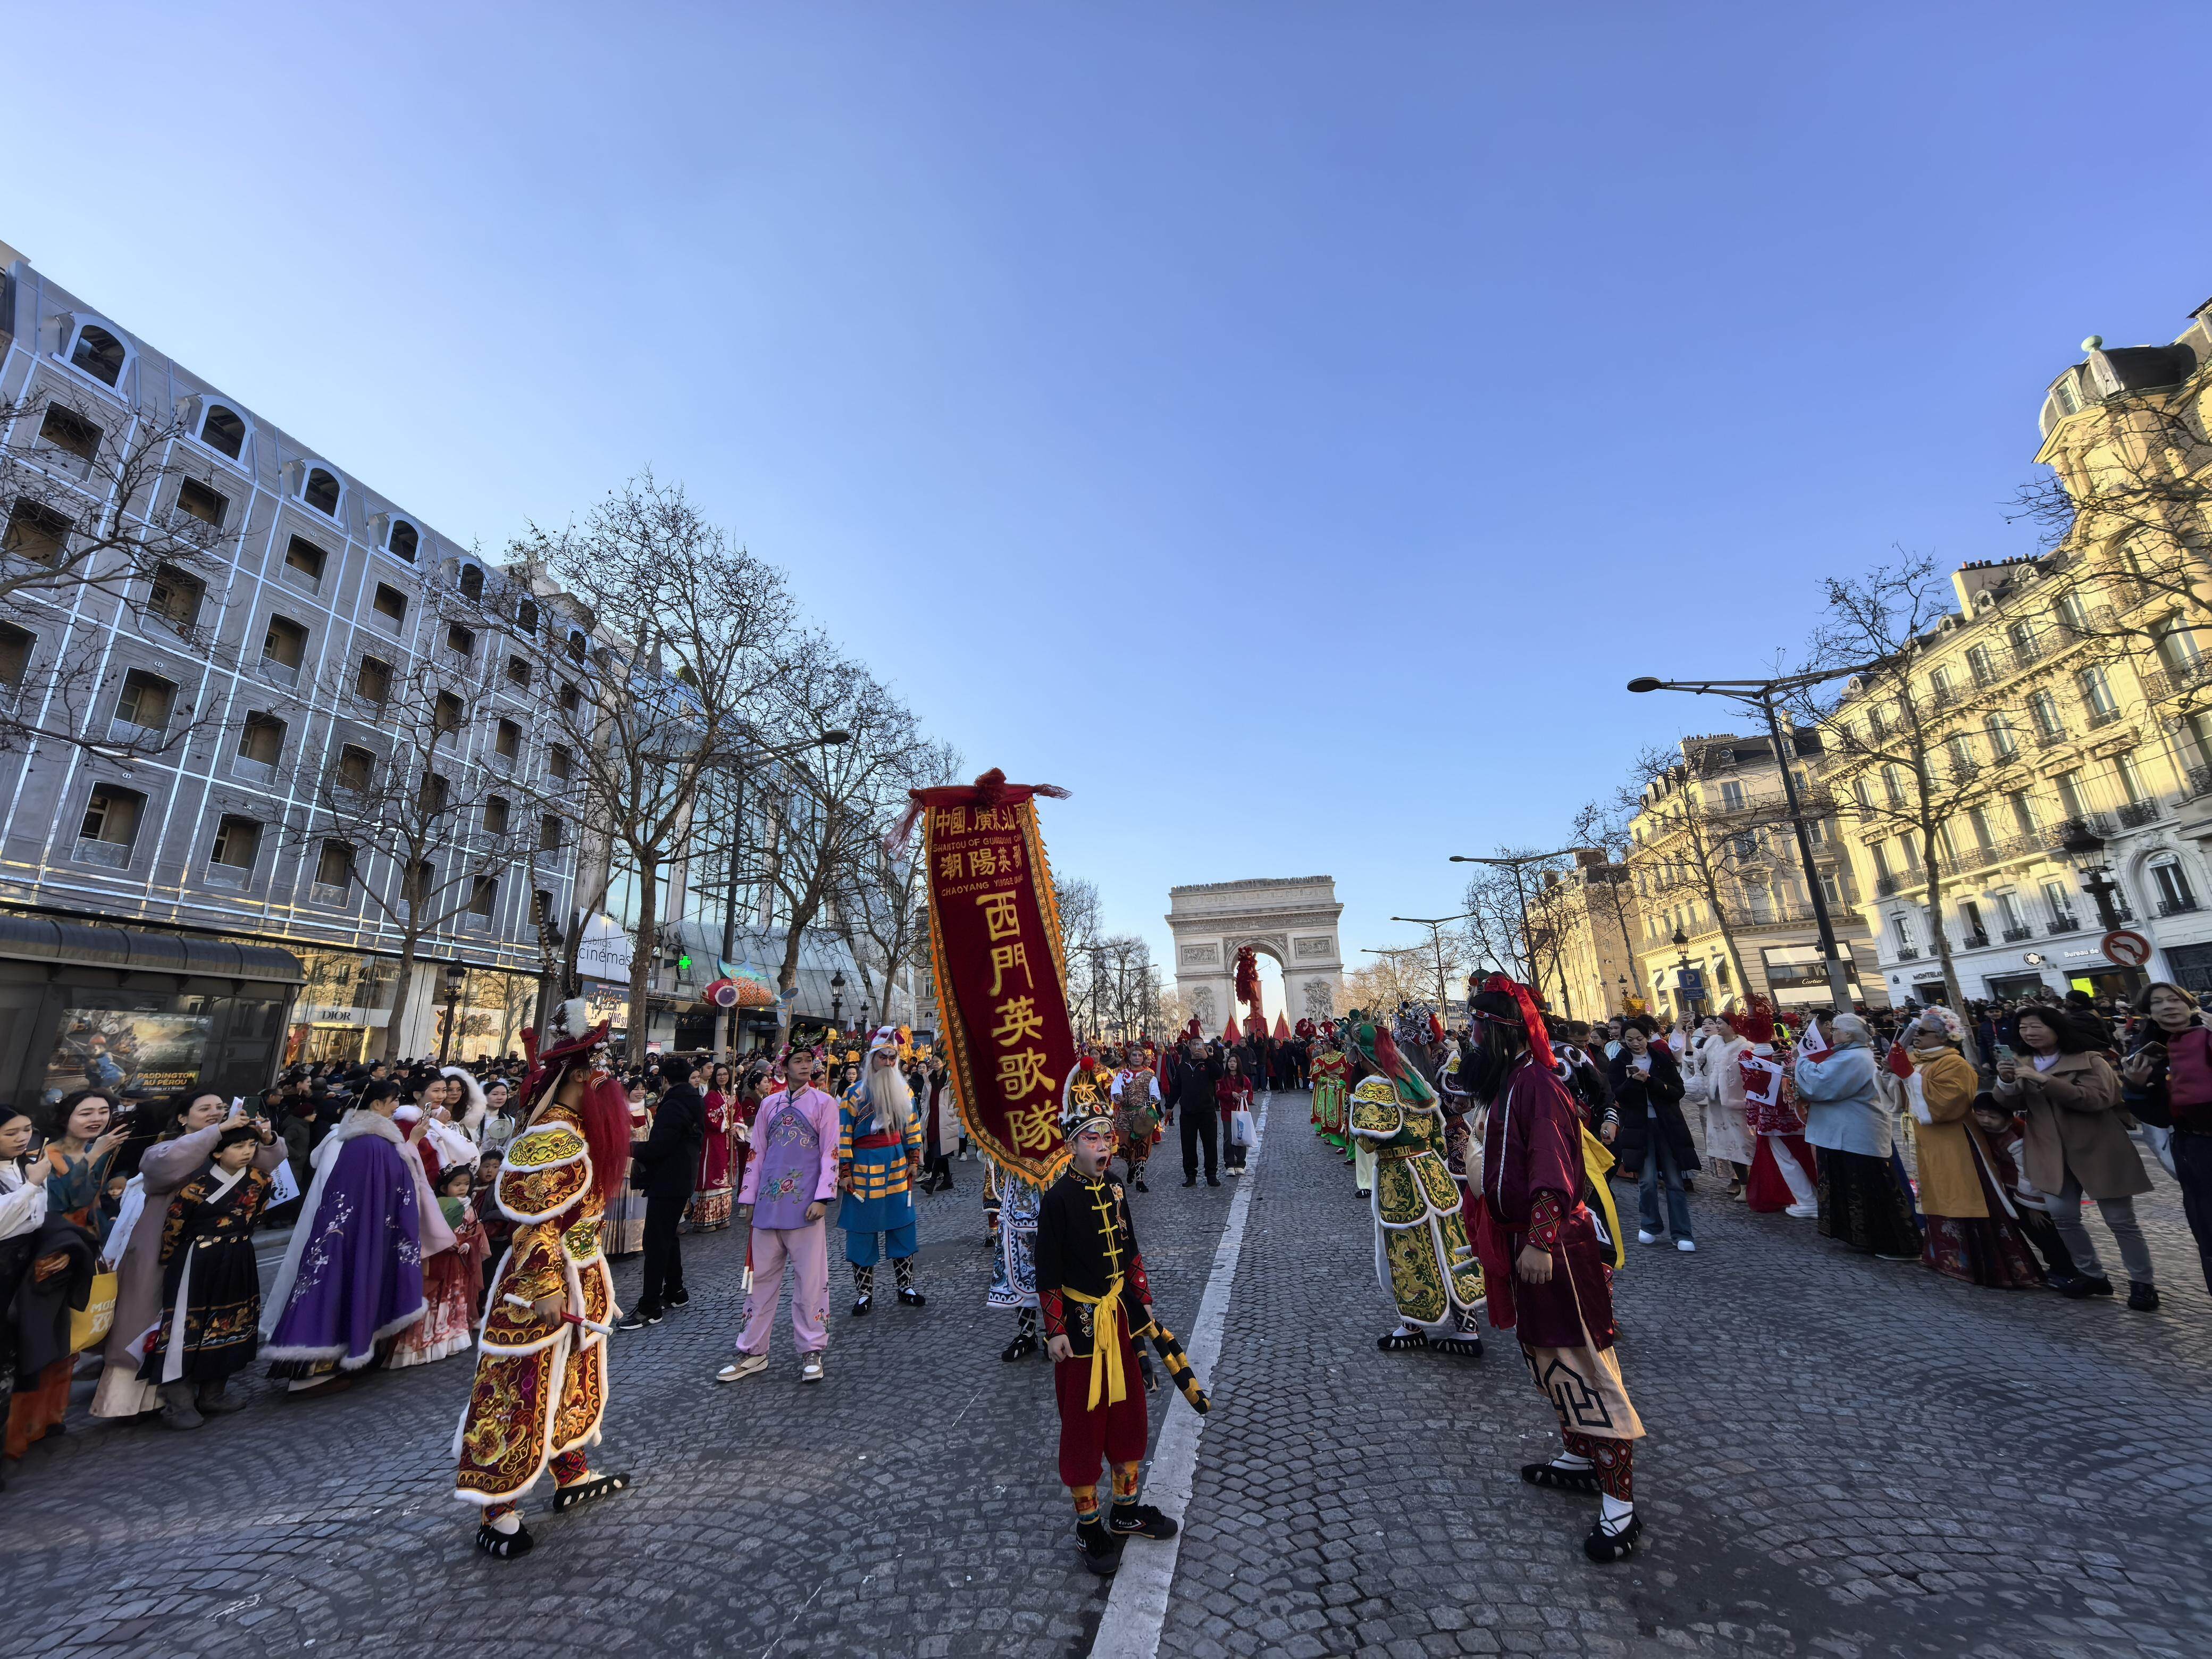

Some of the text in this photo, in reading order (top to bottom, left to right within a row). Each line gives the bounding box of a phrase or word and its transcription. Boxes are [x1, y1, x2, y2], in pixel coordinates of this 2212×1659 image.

[968, 838, 980, 847] OF
[941, 882, 989, 896] CHAOYANG
[579, 946, 631, 966] cinémas
[1686, 974, 1695, 985] P
[1913, 971, 1943, 979] MONTBLAN
[322, 1011, 351, 1020] DIOR
[976, 890, 1062, 1155] 西門英歌隊
